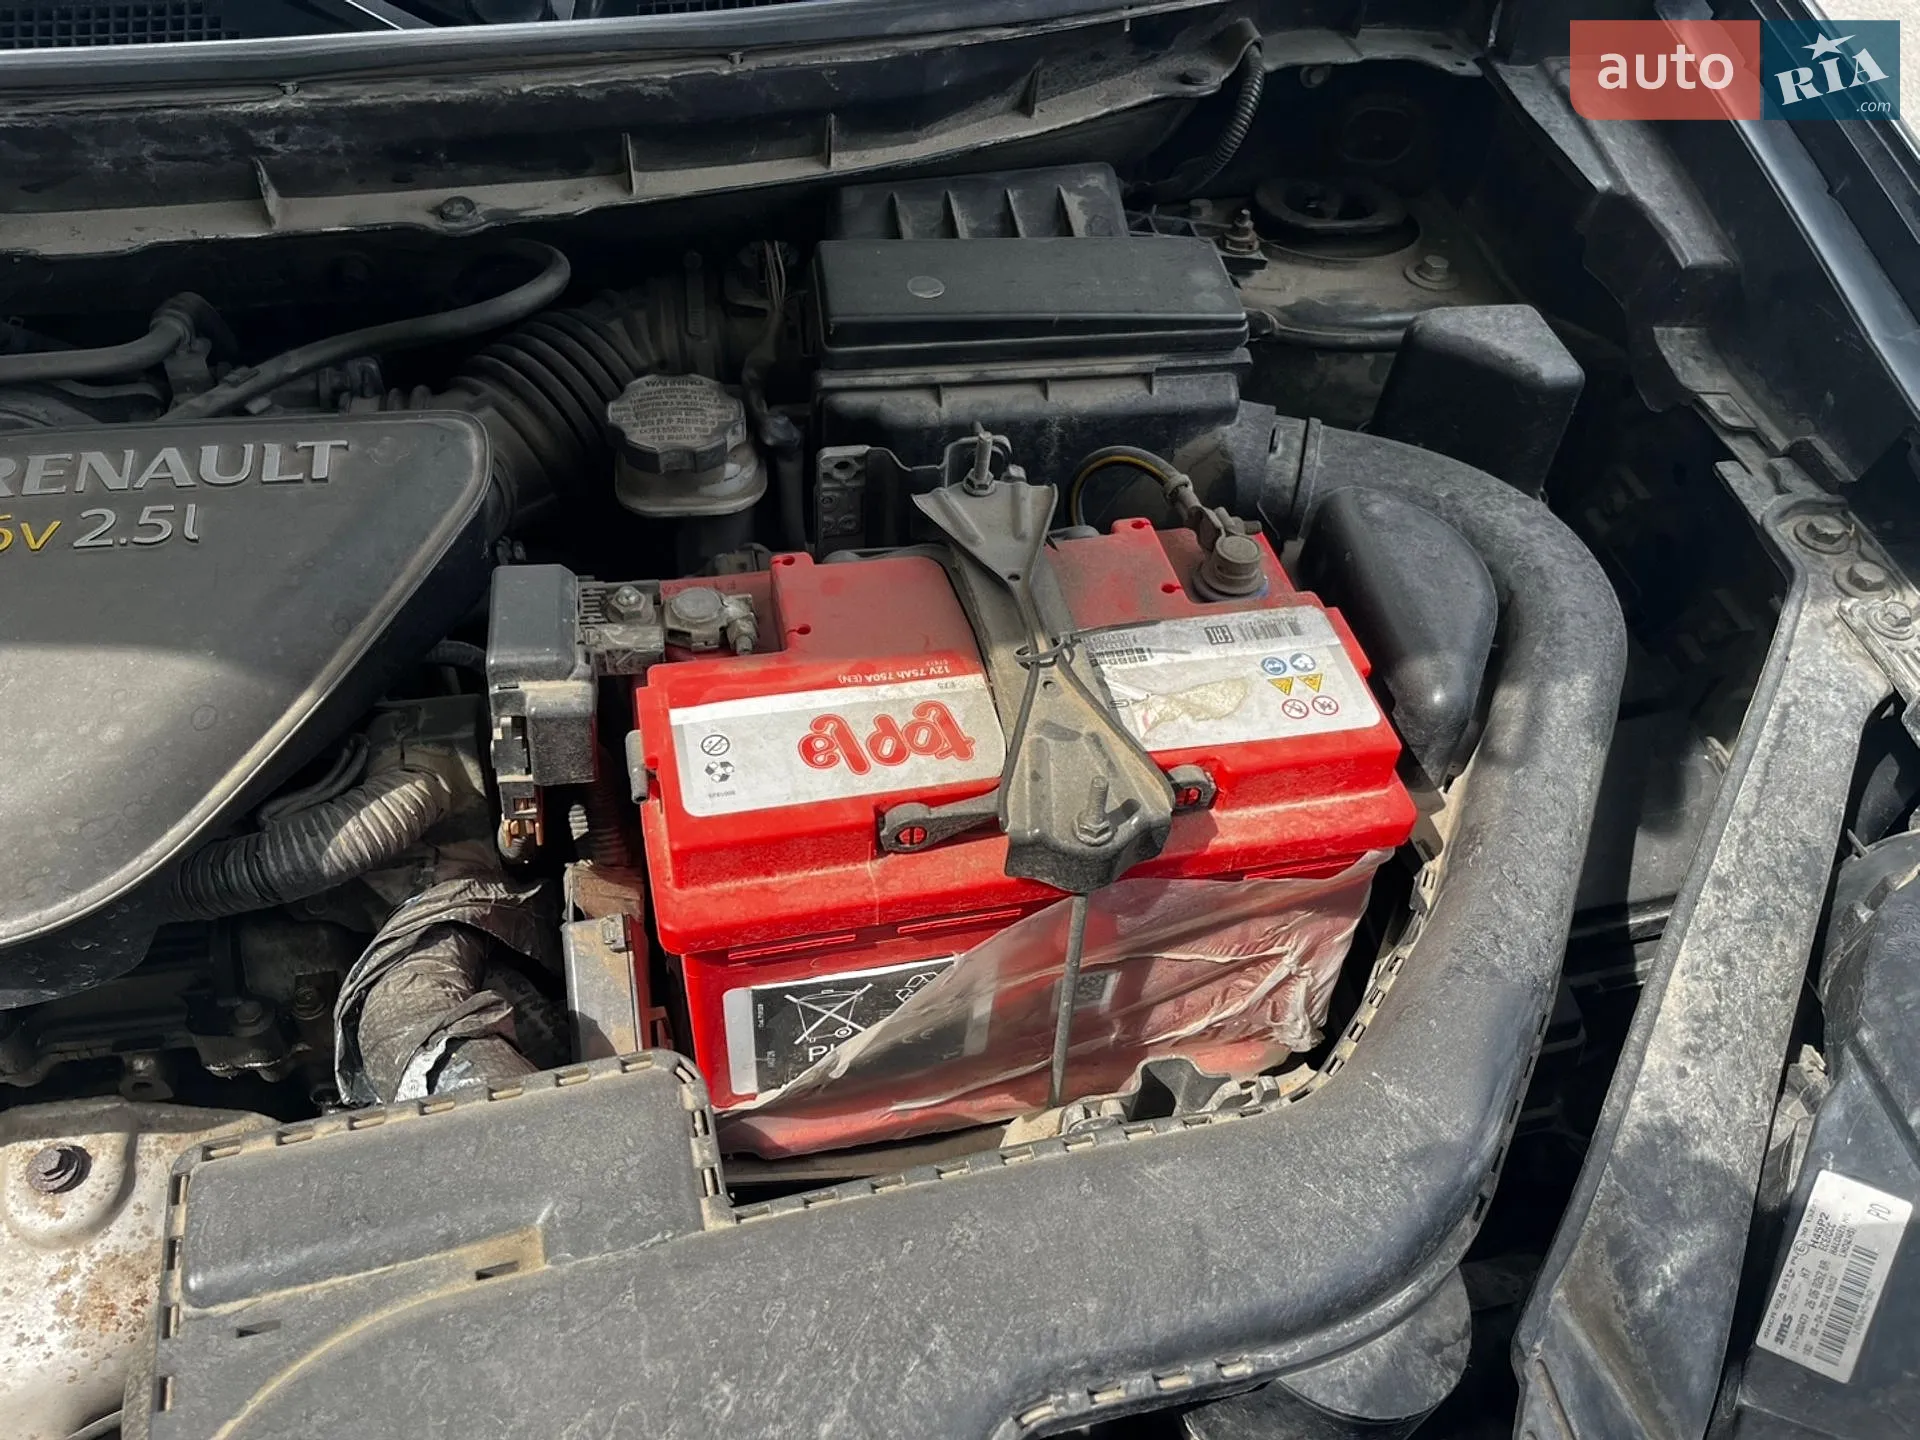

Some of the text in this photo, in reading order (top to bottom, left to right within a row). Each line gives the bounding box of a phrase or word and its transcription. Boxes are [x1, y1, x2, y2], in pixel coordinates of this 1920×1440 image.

[837, 664, 951, 684] 12V 75Ah 750A (EN)
[797, 701, 976, 777] topla
[808, 1043, 838, 1063] P
[1808, 1210, 1830, 1249] H45P2
